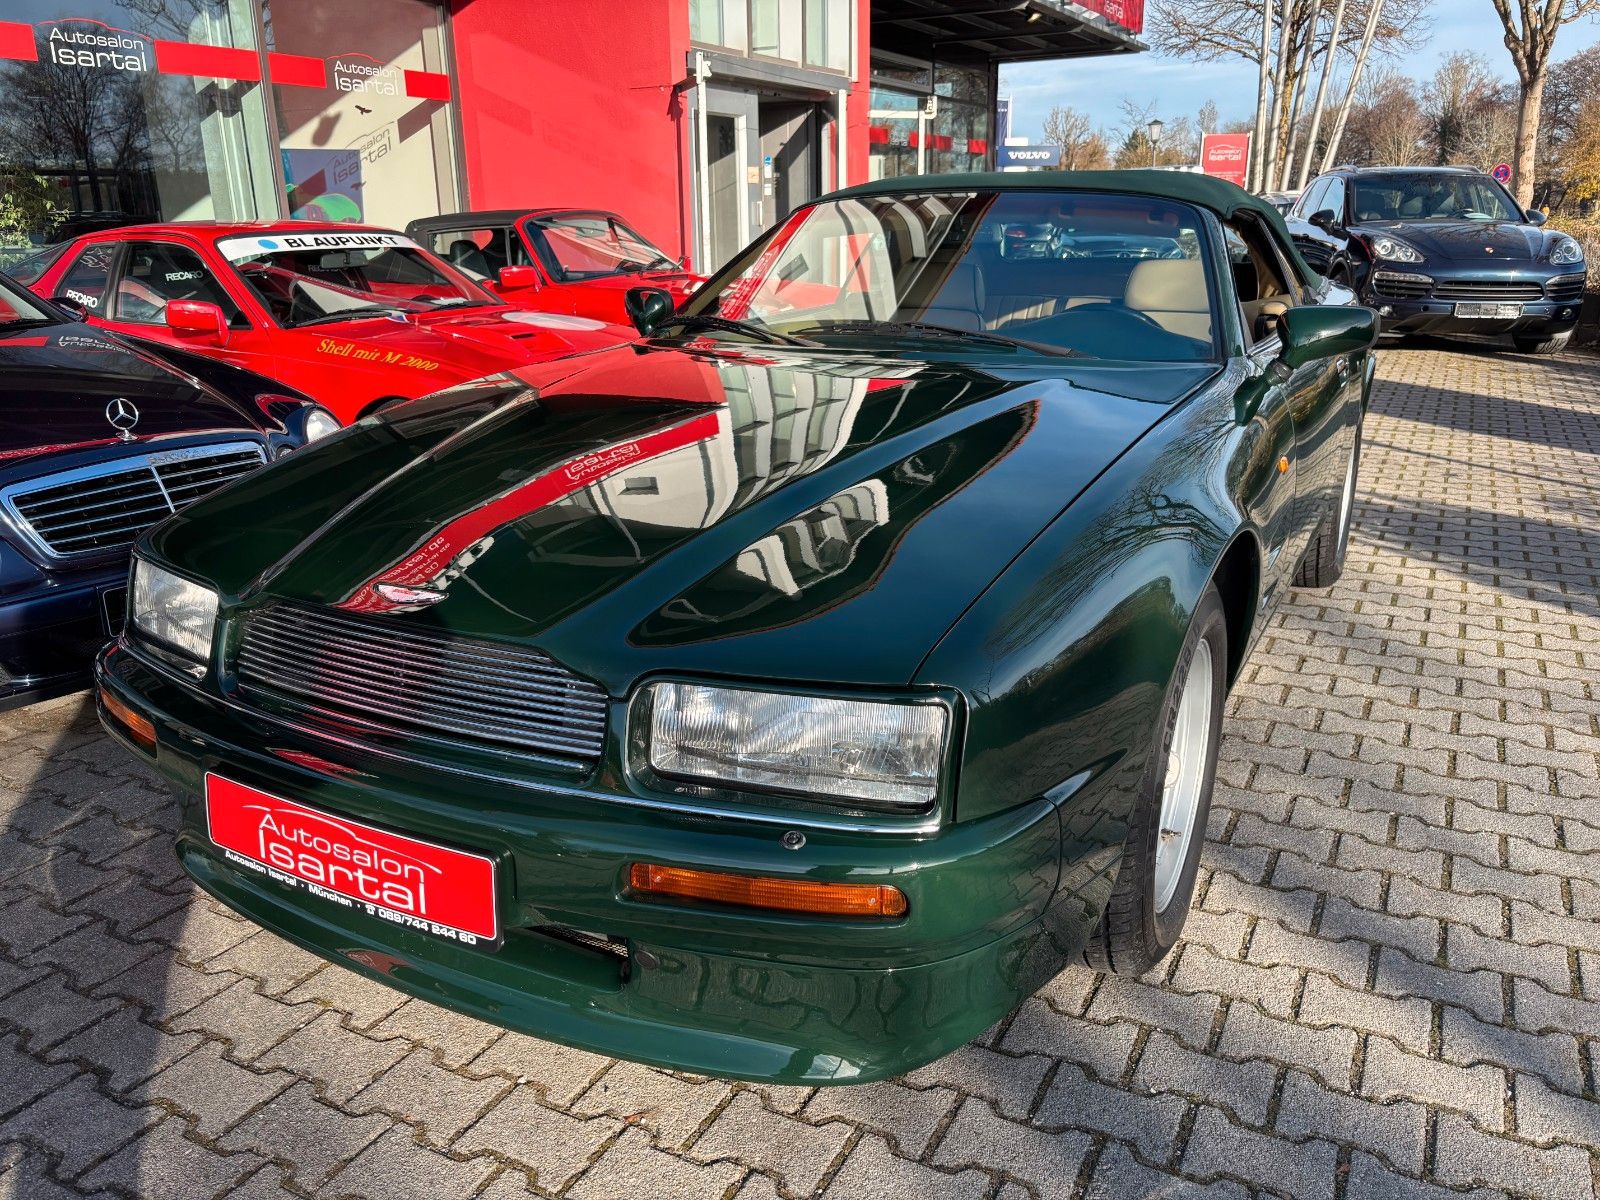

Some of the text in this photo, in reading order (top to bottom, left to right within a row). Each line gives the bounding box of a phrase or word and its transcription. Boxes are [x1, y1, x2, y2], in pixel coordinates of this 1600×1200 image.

[49, 27, 144, 50] Autosalon
[50, 41, 148, 72] Isartal
[334, 60, 397, 80] Autosalon
[334, 71, 399, 96] Isartal
[1008, 151, 1051, 160] VOLVO
[284, 235, 400, 249] BLAUPUNKT
[165, 271, 204, 282] RECARO
[66, 290, 98, 309] RECARO
[316, 338, 439, 371] Shell mit M 2000
[259, 814, 424, 883] Autosalon
[259, 829, 426, 914] Isartal
[225, 851, 477, 945] Autosalon Isartal München 089/744 244 60
